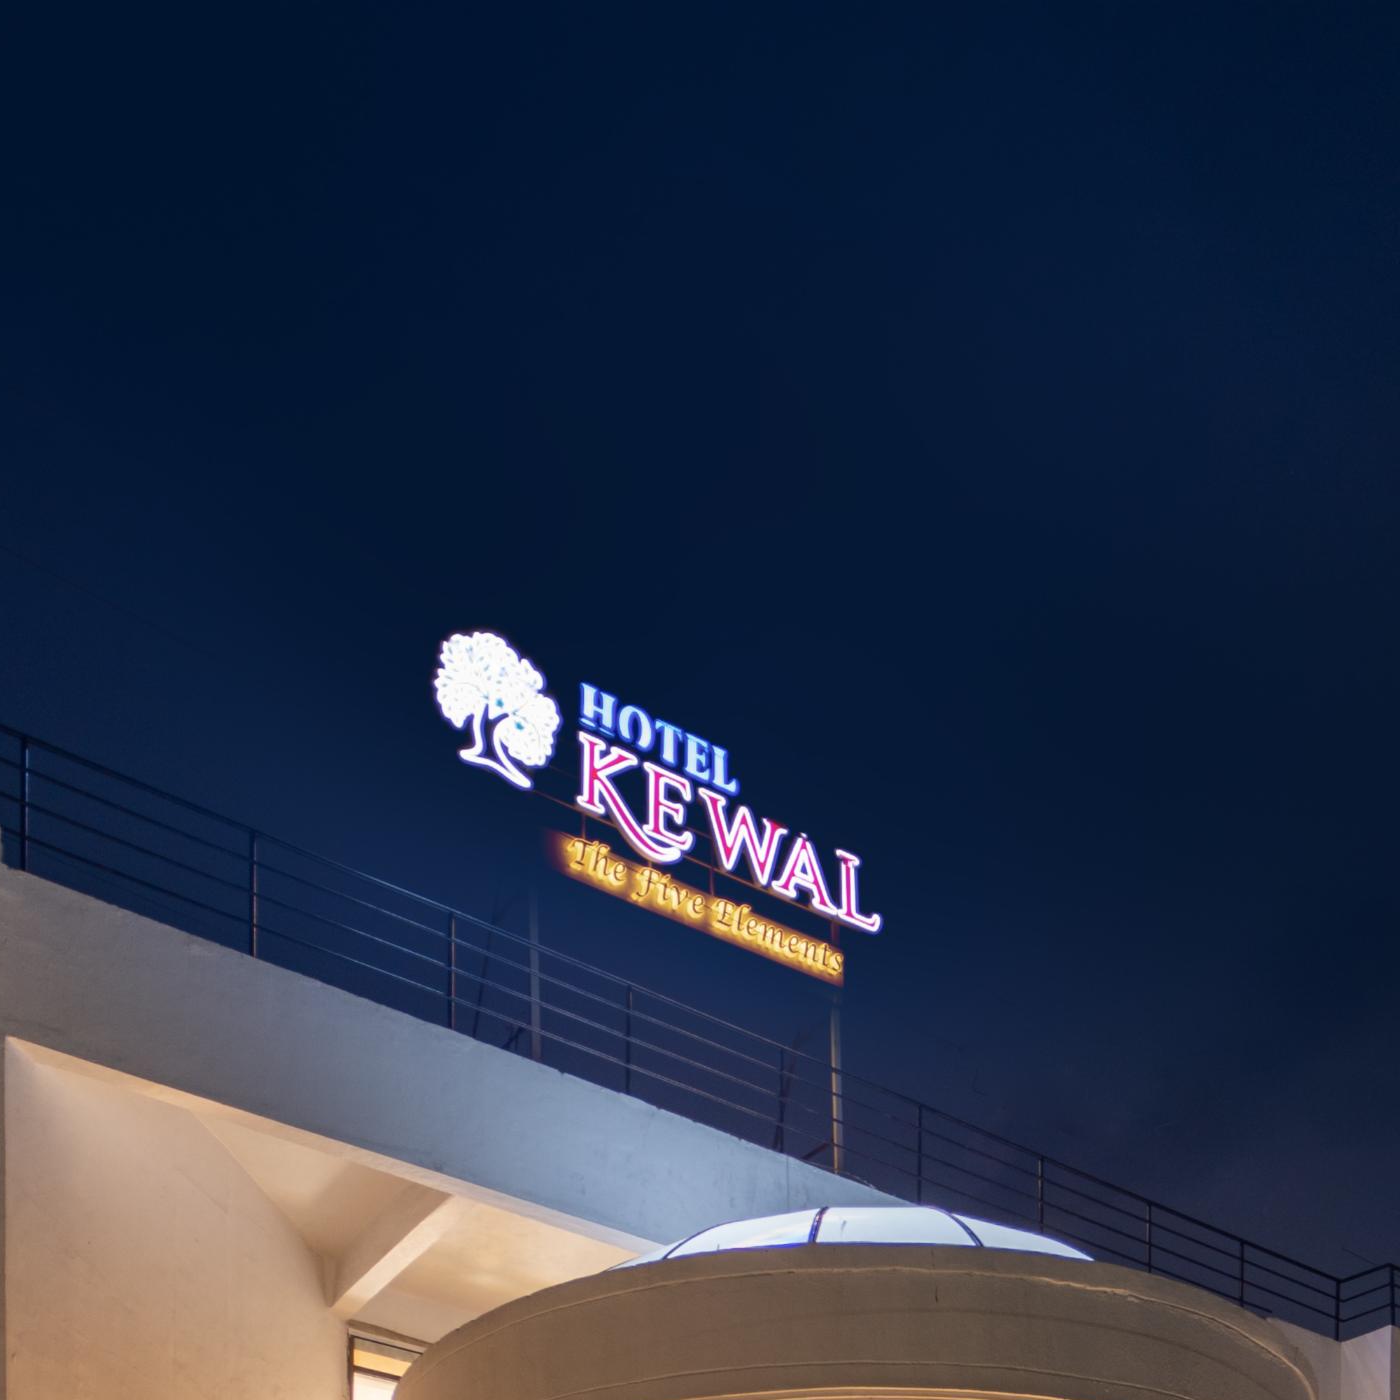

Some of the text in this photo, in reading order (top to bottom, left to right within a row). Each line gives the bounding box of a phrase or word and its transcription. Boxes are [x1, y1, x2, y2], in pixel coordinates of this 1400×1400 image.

[579, 681, 740, 796] HOTEL
[575, 731, 882, 933] KEWAL
[571, 838, 846, 976] The Five Elements
